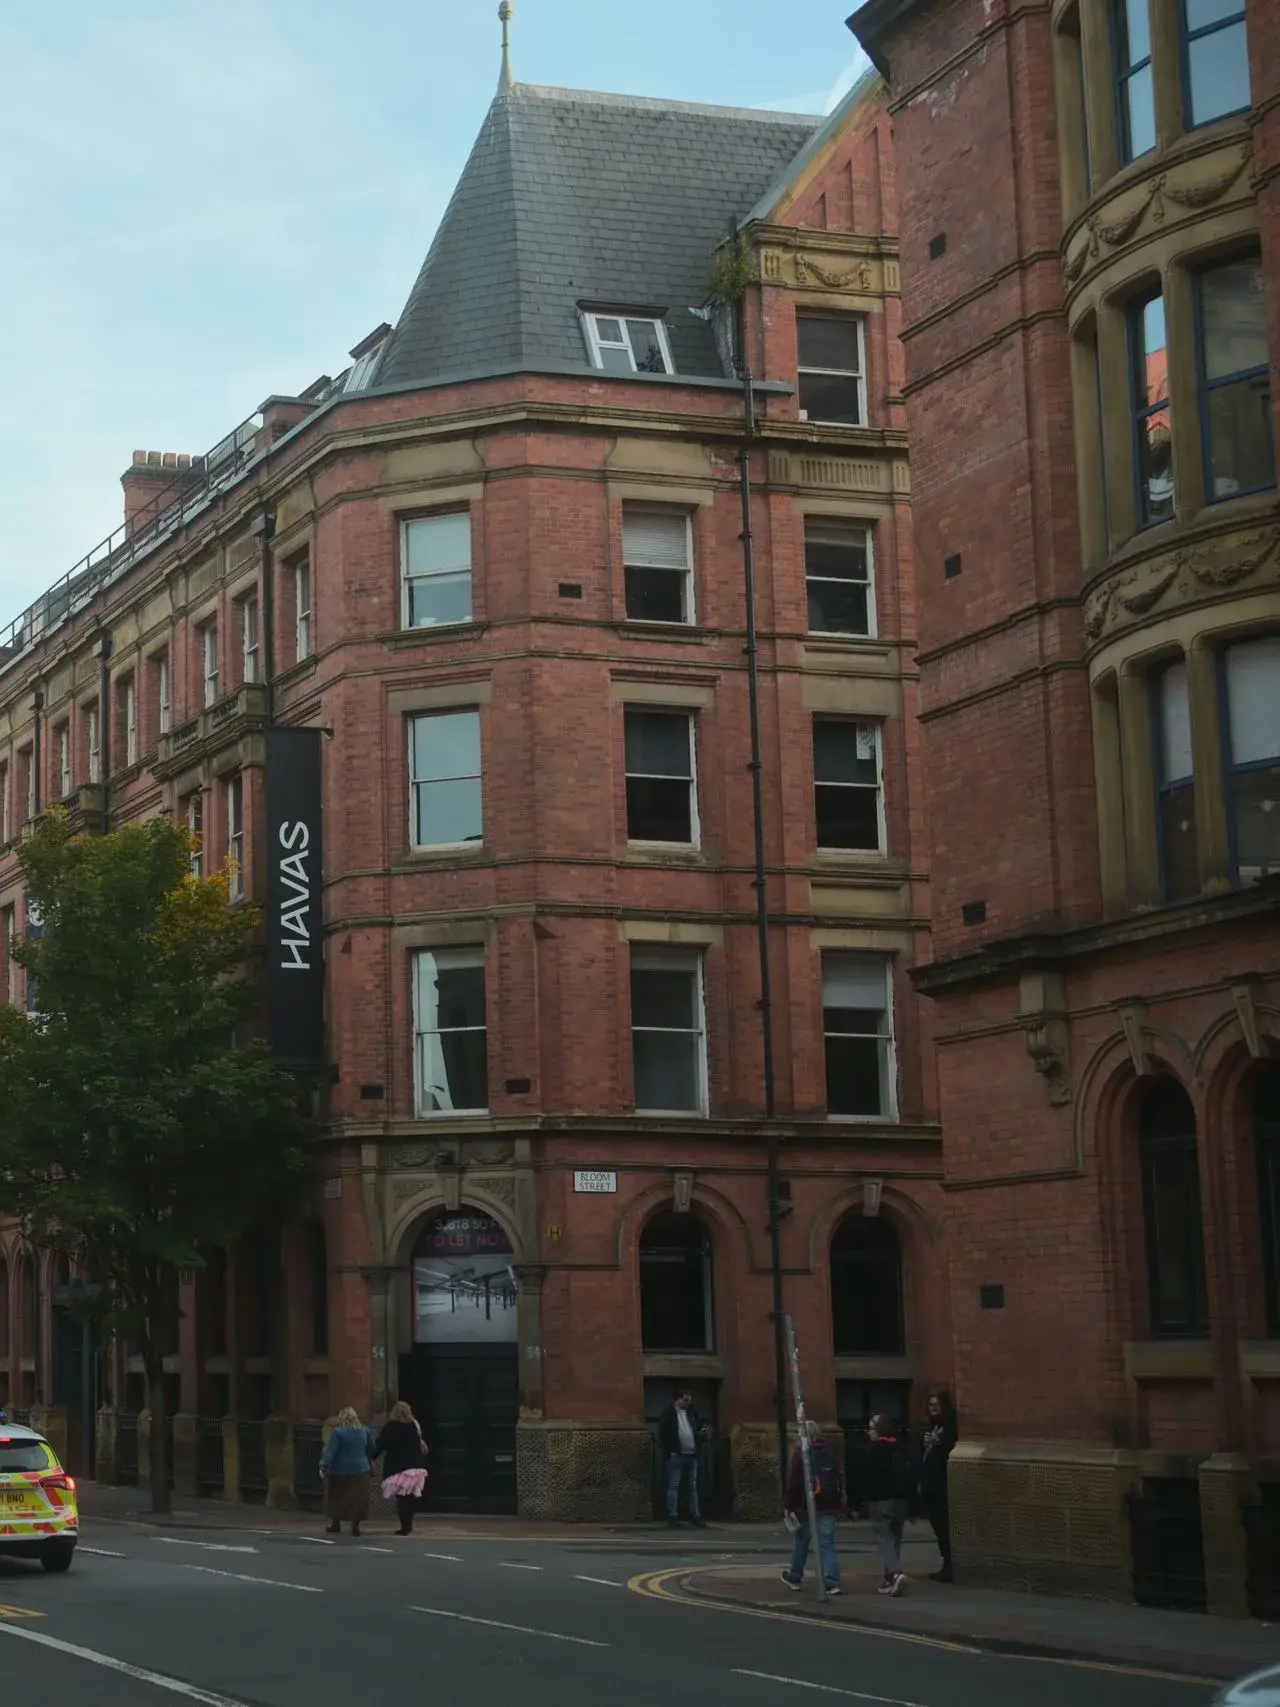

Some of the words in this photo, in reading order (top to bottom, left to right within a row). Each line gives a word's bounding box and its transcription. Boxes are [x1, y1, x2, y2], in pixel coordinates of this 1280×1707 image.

[279, 820, 310, 970] HAVAS
[580, 1173, 611, 1181] BLOOM
[579, 1182, 611, 1191] STREET
[434, 1218, 469, 1231] 3,818
[549, 1226, 560, 1239] H
[426, 1234, 445, 1247] TO
[448, 1234, 471, 1247] LET
[476, 1234, 506, 1247] NO
[372, 1344, 385, 1359] 54
[6, 1493, 25, 1503] BNO
